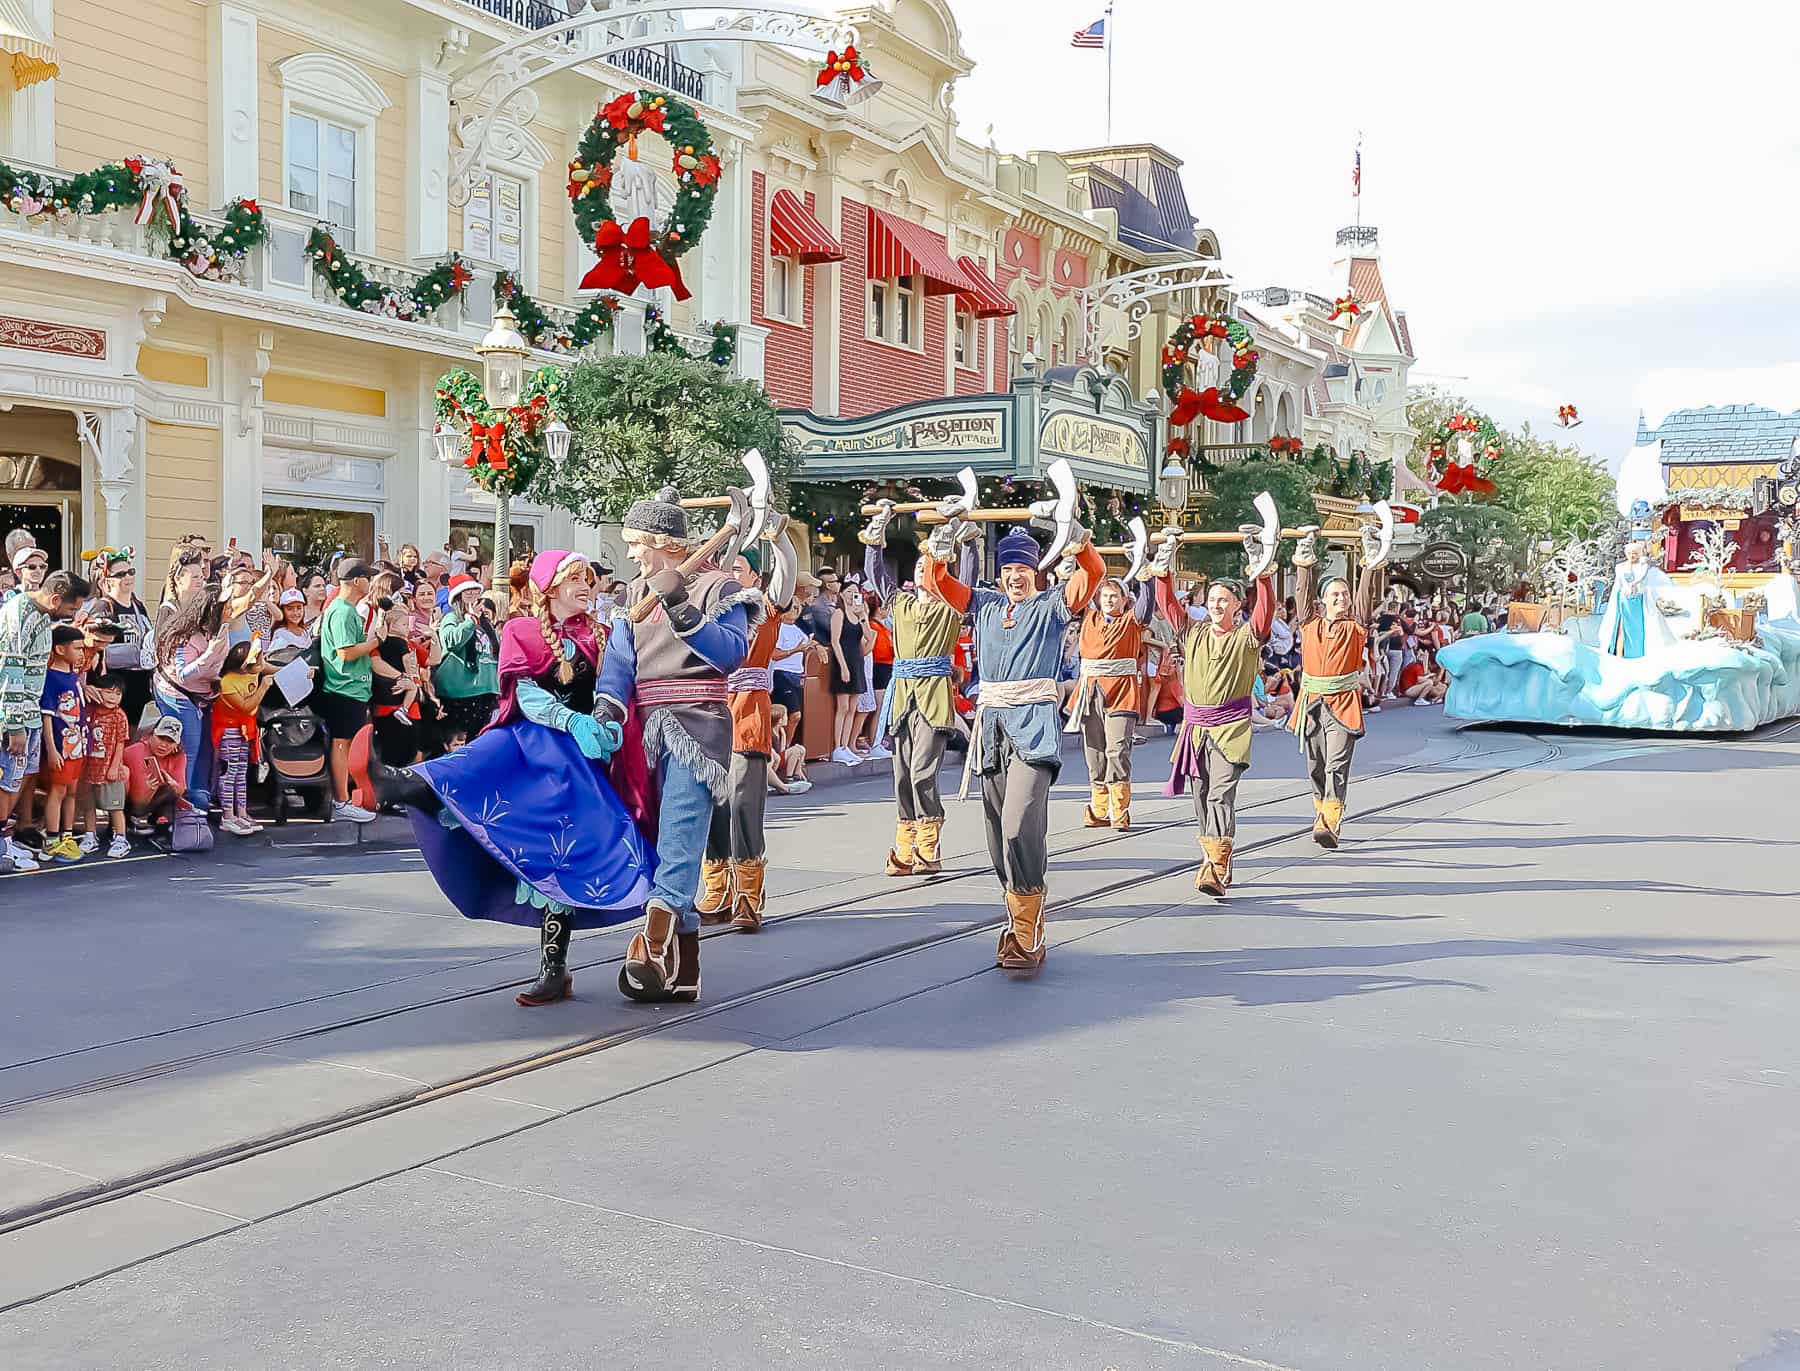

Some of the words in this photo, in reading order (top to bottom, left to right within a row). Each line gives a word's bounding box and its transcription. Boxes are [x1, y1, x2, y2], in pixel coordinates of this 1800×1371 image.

[834, 439, 861, 453] Main
[863, 428, 897, 449] Street
[907, 417, 997, 449] FASHION
[950, 433, 999, 447] APPAREL
